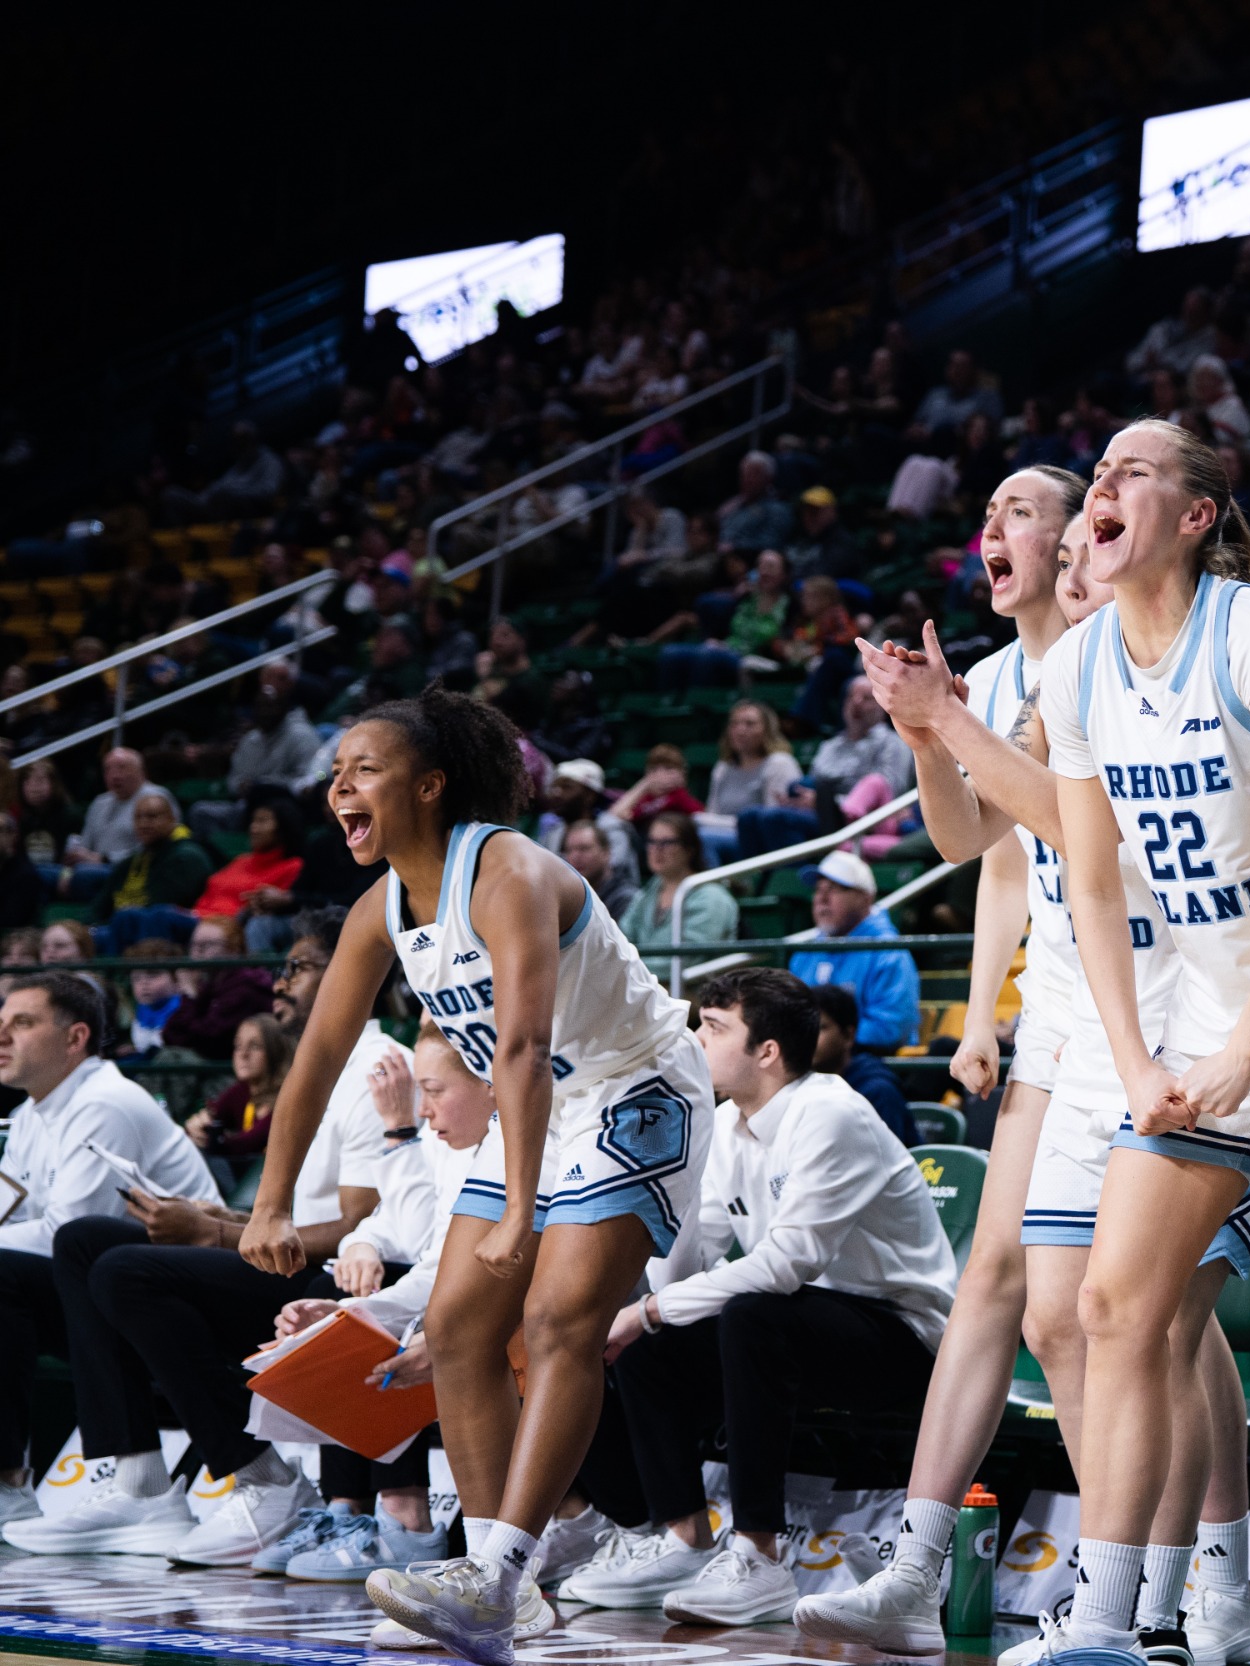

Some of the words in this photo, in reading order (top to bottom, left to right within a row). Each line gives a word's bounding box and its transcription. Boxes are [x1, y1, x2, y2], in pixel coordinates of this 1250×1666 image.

[1104, 754, 1234, 801] RHODE
[1137, 810, 1218, 882] 22
[417, 975, 495, 1017] HODE
